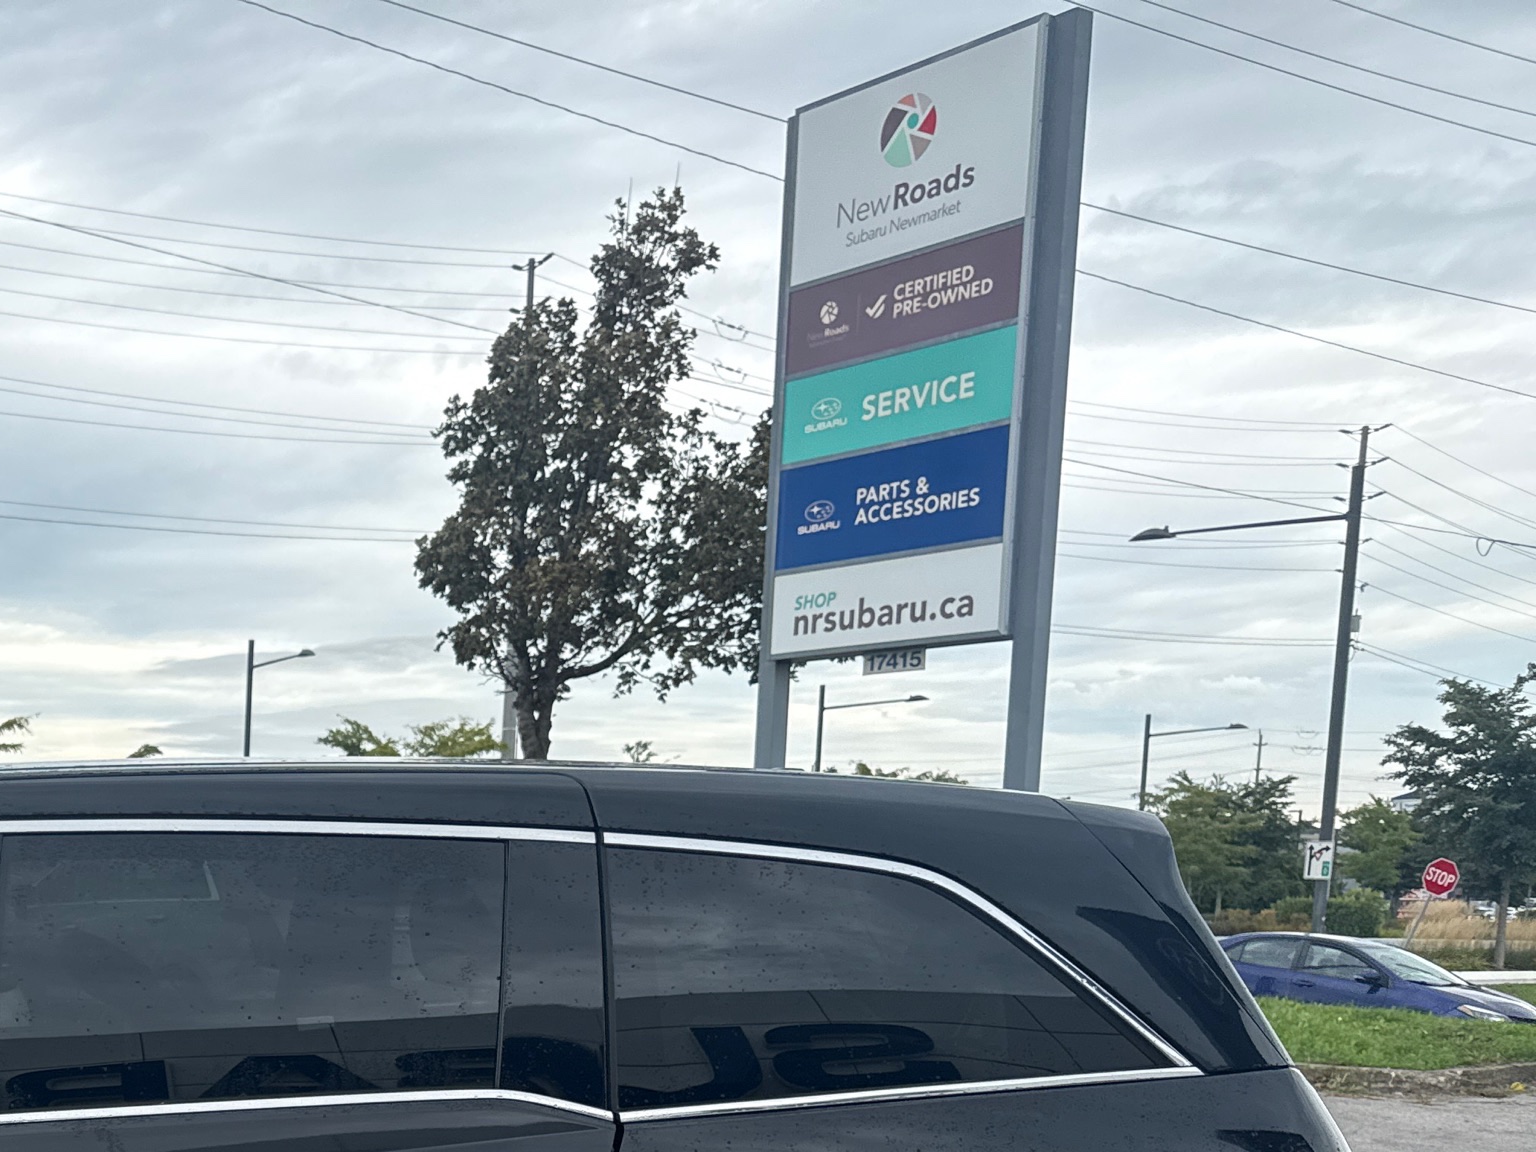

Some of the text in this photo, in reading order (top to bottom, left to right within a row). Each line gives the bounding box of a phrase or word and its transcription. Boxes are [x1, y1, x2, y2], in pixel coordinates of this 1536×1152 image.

[845, 200, 962, 247] Subaru Newmarket
[892, 278, 993, 319] PRE-OWNED
[893, 265, 975, 301] CERTIFIED
[861, 371, 976, 421] SERVICE
[803, 417, 848, 434] SUBARU
[854, 487, 980, 526] ACCESSORIES
[855, 477, 930, 506] PARTS &
[797, 520, 841, 535] SUBARU
[793, 593, 975, 637] nrsubaru.ca
[794, 591, 837, 611] SHOP
[867, 651, 923, 673] 17415
[1425, 866, 1456, 888] STOP
